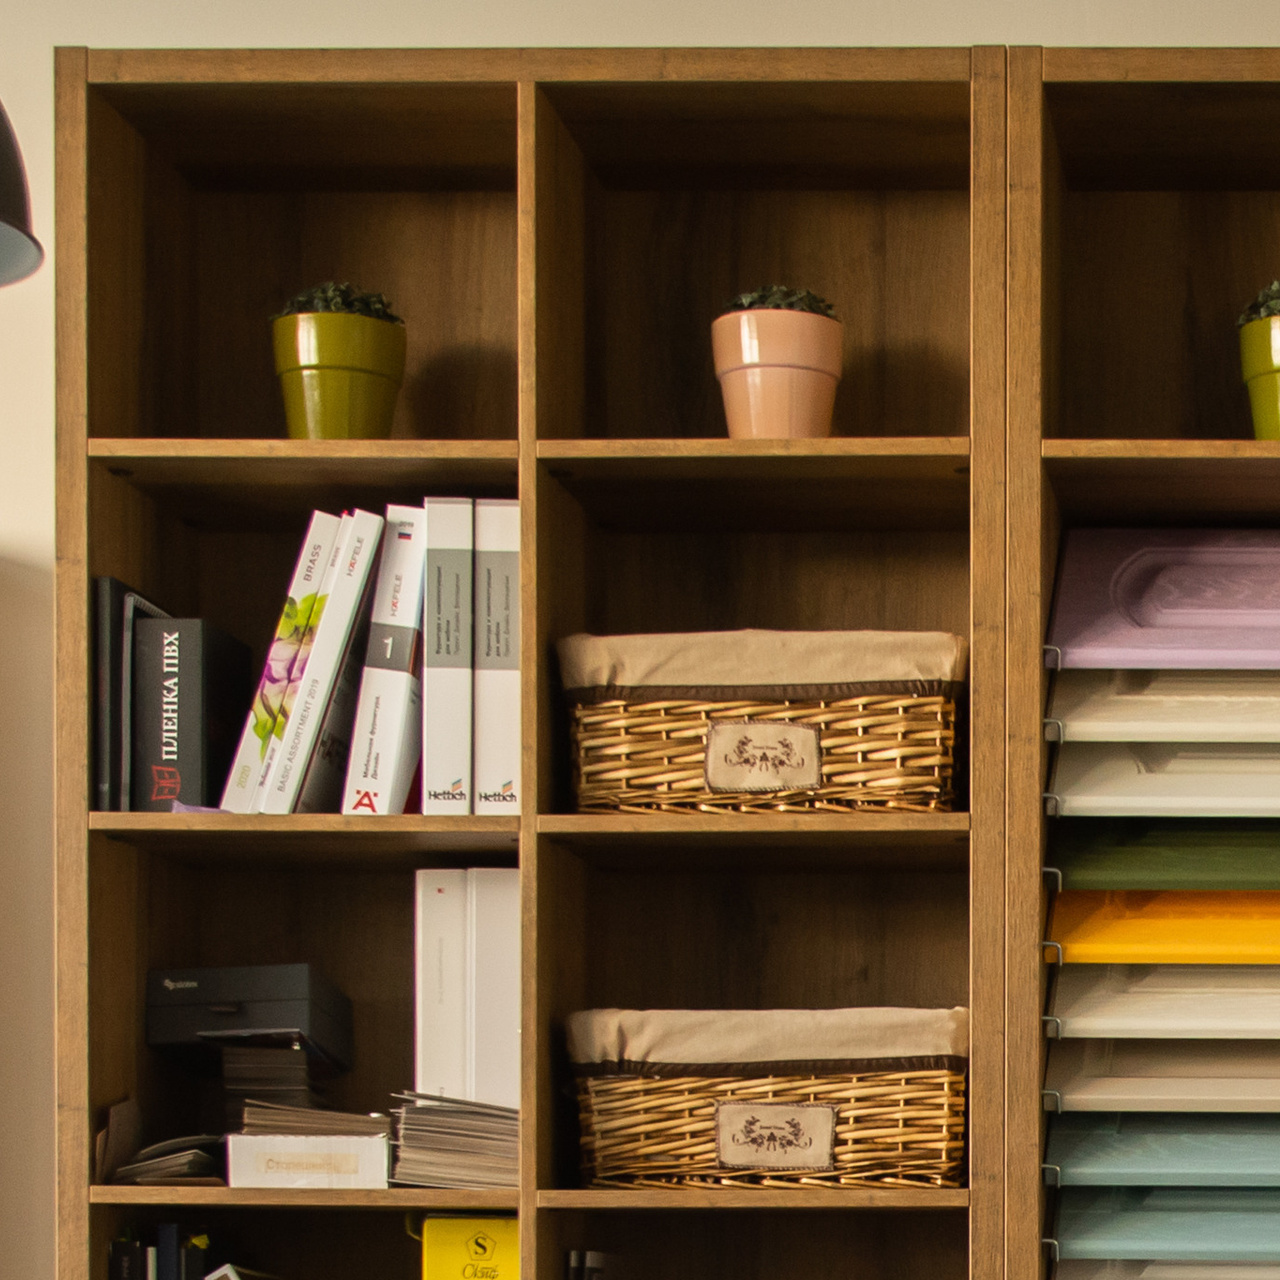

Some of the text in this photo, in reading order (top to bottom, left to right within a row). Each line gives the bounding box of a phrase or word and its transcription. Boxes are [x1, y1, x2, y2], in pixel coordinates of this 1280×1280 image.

[303, 543, 322, 582] BRASS
[162, 631, 179, 761] ПЛЕНКА ПВХ
[277, 679, 320, 793] BASIC ASSORTMENT 2019
[428, 790, 467, 801] Hettich
[479, 792, 517, 802] Hettich
[474, 1236, 488, 1256] S
